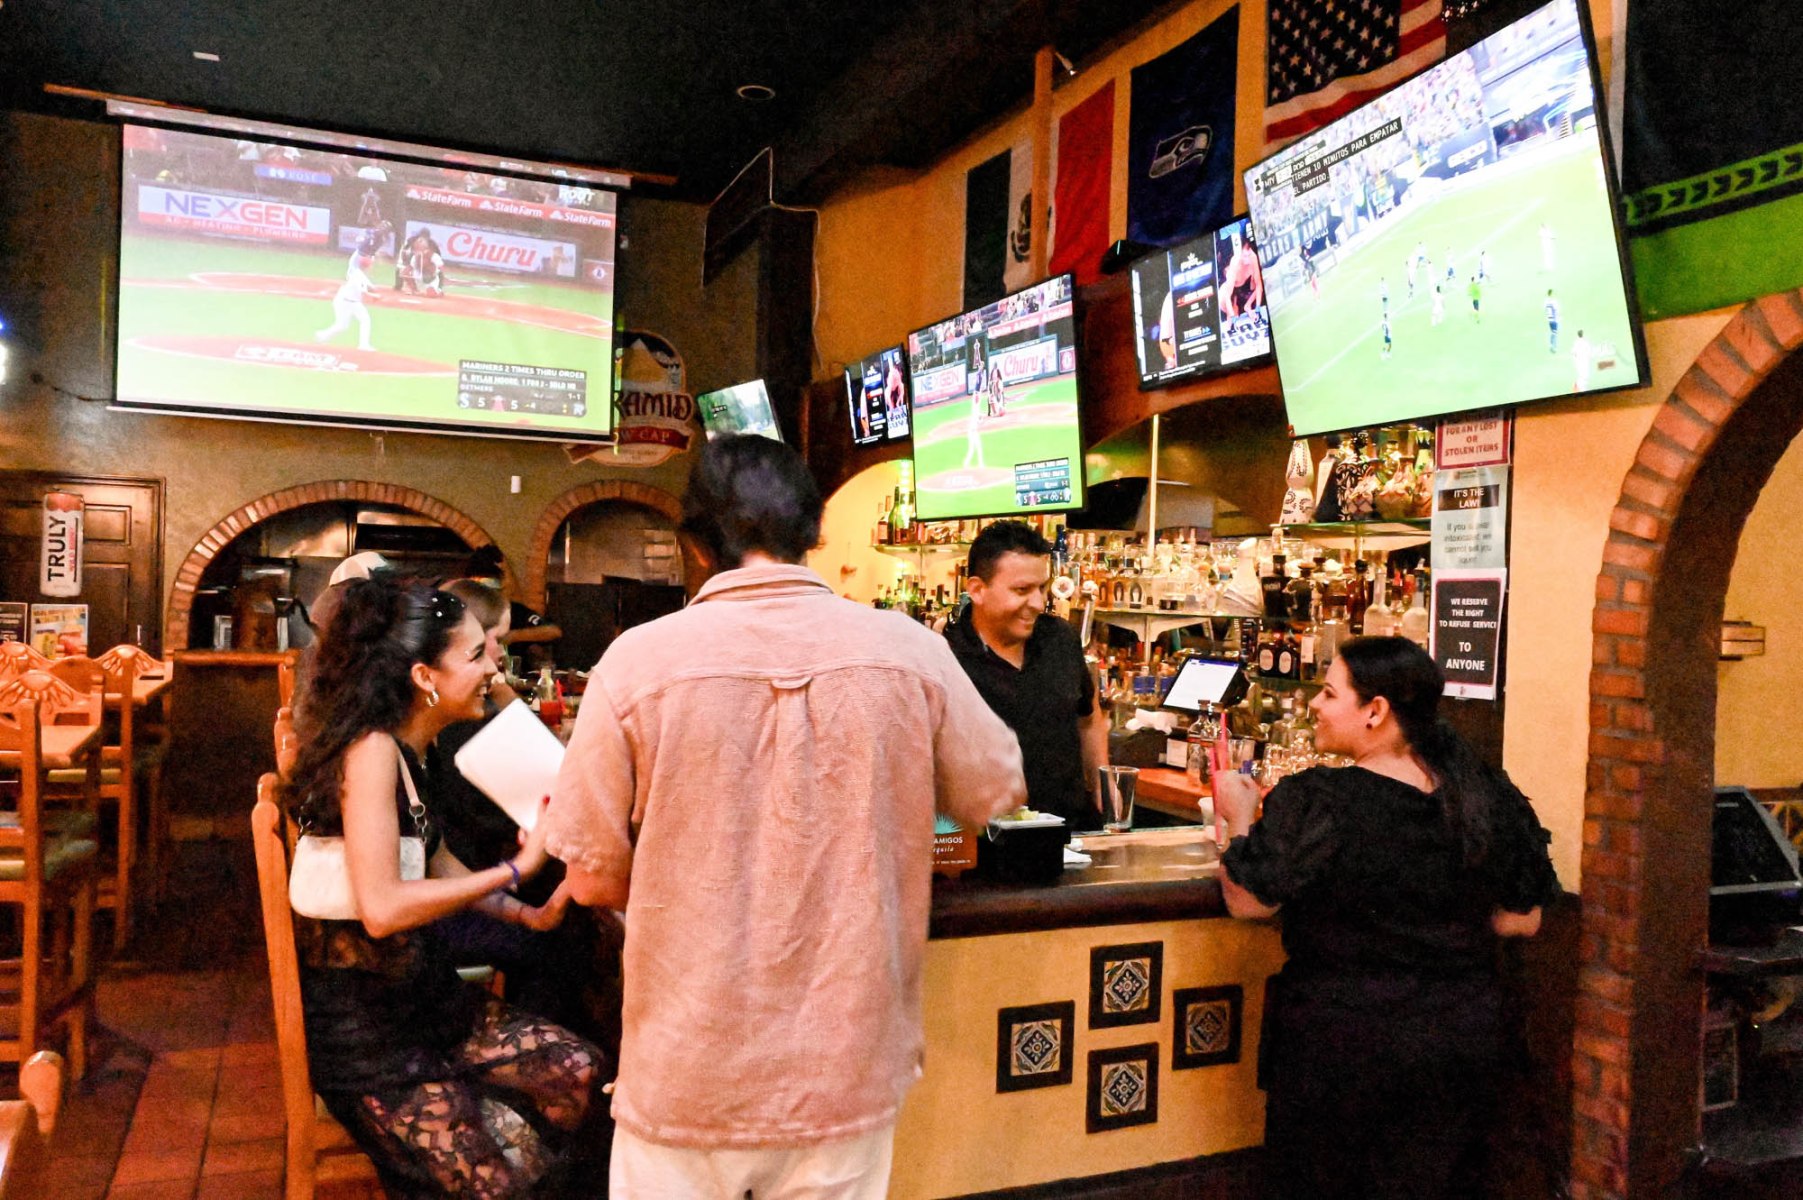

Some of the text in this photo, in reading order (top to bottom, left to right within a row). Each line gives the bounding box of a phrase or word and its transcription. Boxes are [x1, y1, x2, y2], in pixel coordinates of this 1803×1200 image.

[1314, 162, 1321, 172] 10
[1323, 147, 1349, 168] MINUTOS
[1351, 138, 1367, 153] PARA
[1369, 122, 1399, 143] EMPATAR
[165, 191, 307, 230] NEXGEN
[447, 231, 538, 267] Churu
[462, 361, 503, 371] MARINERS
[511, 366, 535, 374] TIMES
[536, 368, 557, 377] THRU
[559, 370, 585, 379] ORDER
[1004, 354, 1039, 380] Churu
[478, 397, 486, 408] 5
[511, 400, 518, 410] 5
[1446, 421, 1497, 435] FOR ANY LOST
[1466, 434, 1478, 443] OR
[1445, 443, 1499, 456] STOLEN ITEMS
[1454, 487, 1484, 498] IT'S THE
[48, 516, 66, 582] TRULY
[1450, 598, 1488, 606] WE RESERVE
[1465, 609, 1484, 617] RIGHT
[1449, 620, 1470, 628] REFUSE
[1459, 642, 1471, 652] TO
[1445, 659, 1485, 671] ANYONE
